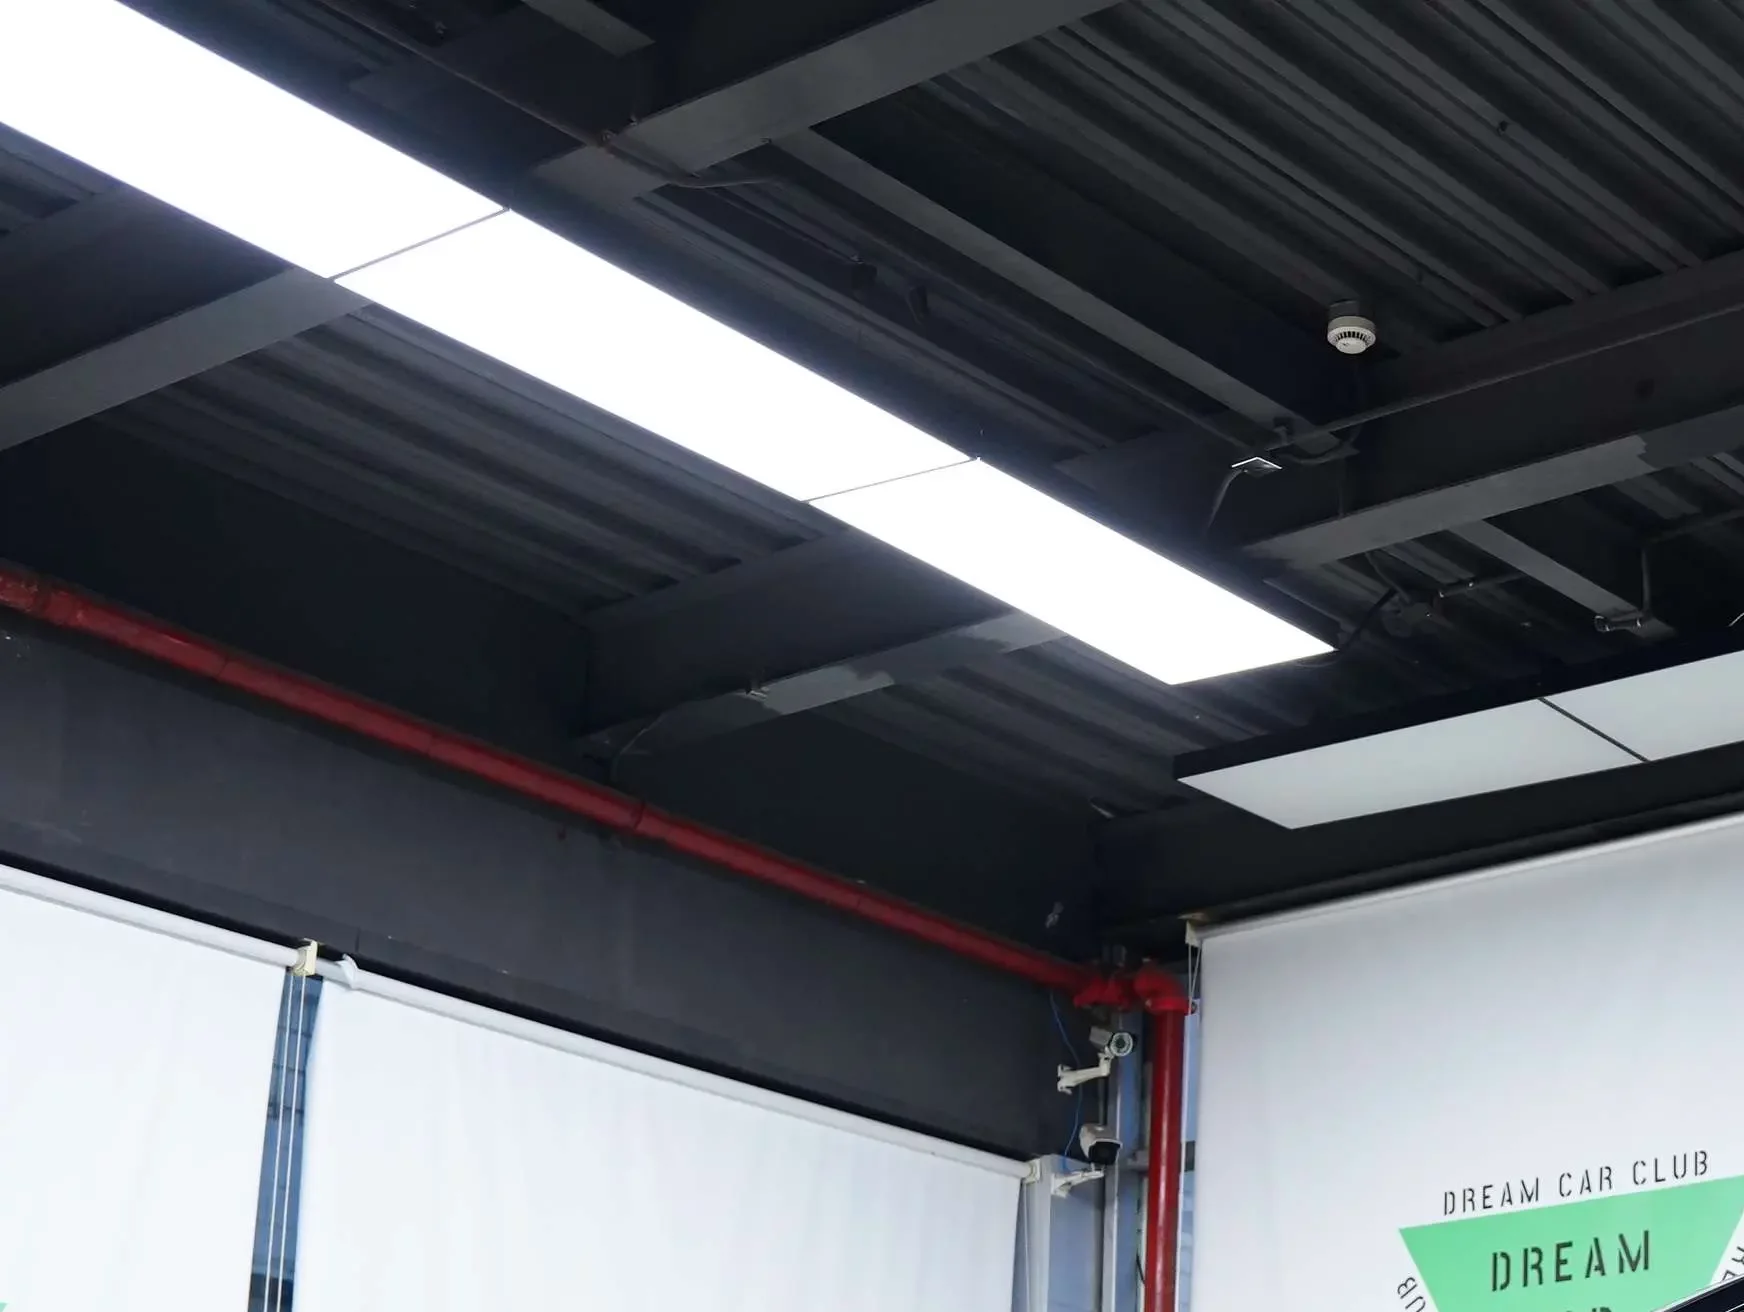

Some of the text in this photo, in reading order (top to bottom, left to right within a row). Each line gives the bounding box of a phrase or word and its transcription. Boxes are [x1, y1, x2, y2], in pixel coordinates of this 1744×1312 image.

[1443, 1150, 1710, 1217] DREAM CAR CLUB
[1491, 1230, 1652, 1293] DREAM
